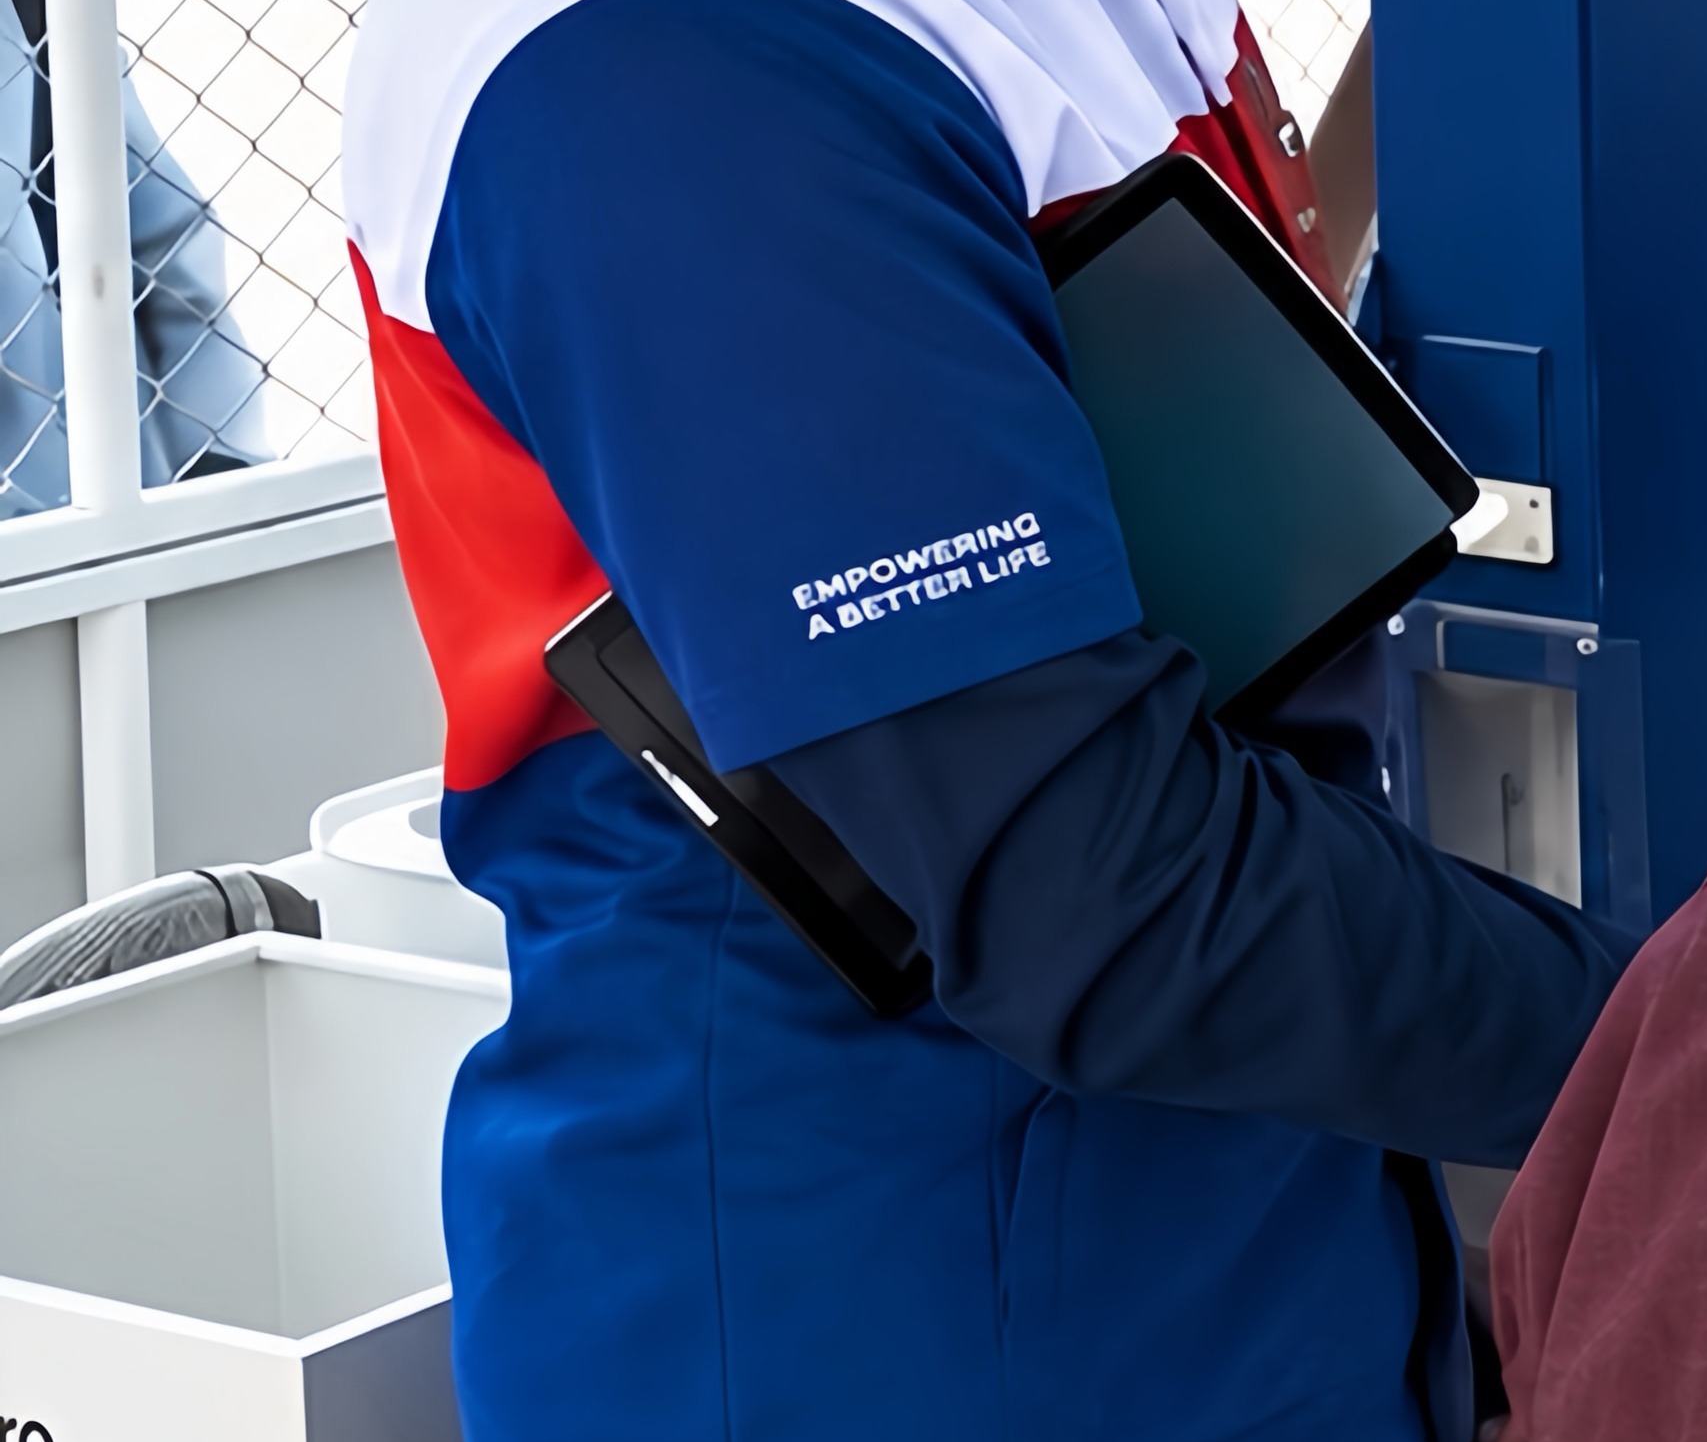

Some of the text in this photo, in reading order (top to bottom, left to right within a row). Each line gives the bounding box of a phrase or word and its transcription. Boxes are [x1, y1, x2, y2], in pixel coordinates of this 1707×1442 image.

[791, 511, 1042, 611] EMPOWERING
[807, 539, 1052, 641] A BETTER LIFE
